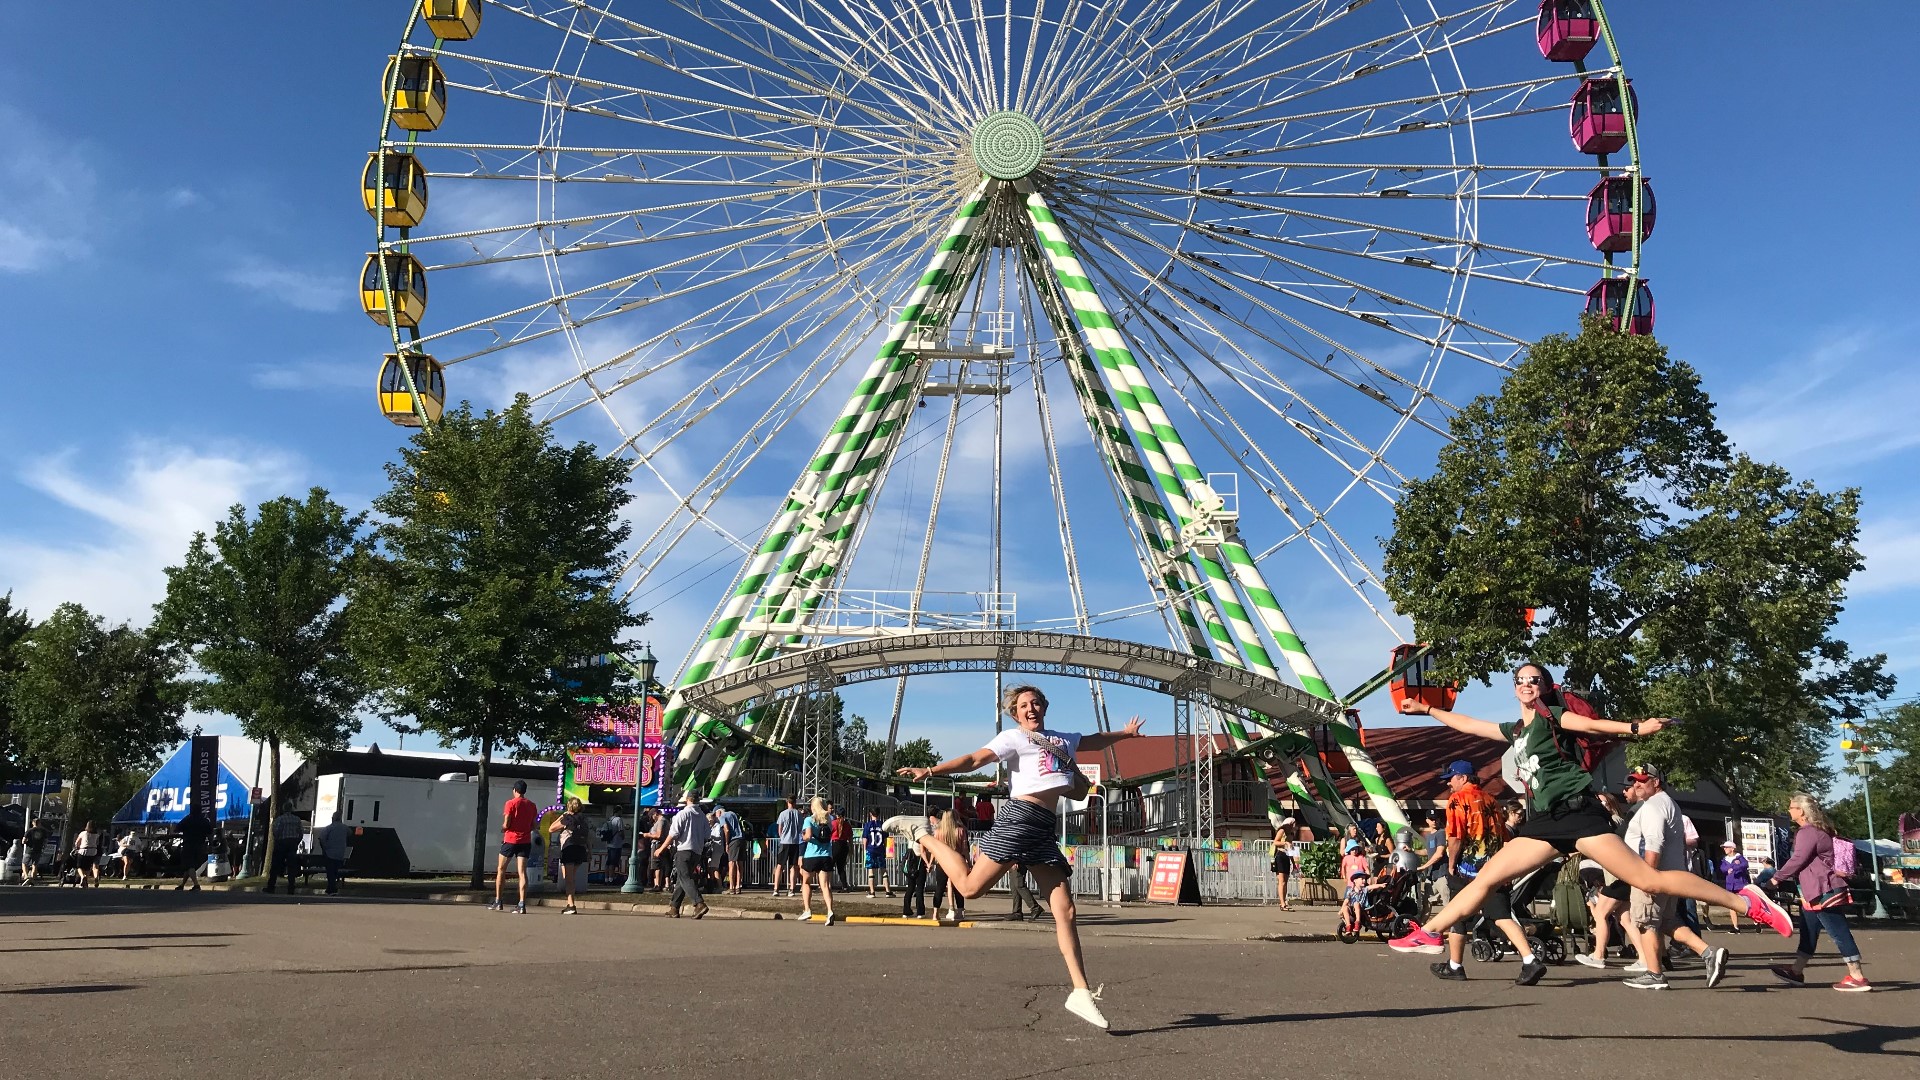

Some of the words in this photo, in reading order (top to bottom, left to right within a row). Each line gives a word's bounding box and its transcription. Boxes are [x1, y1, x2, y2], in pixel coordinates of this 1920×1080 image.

[200, 751, 209, 786] ROADS
[574, 754, 652, 784] TICKETS
[201, 791, 211, 814] NEW
